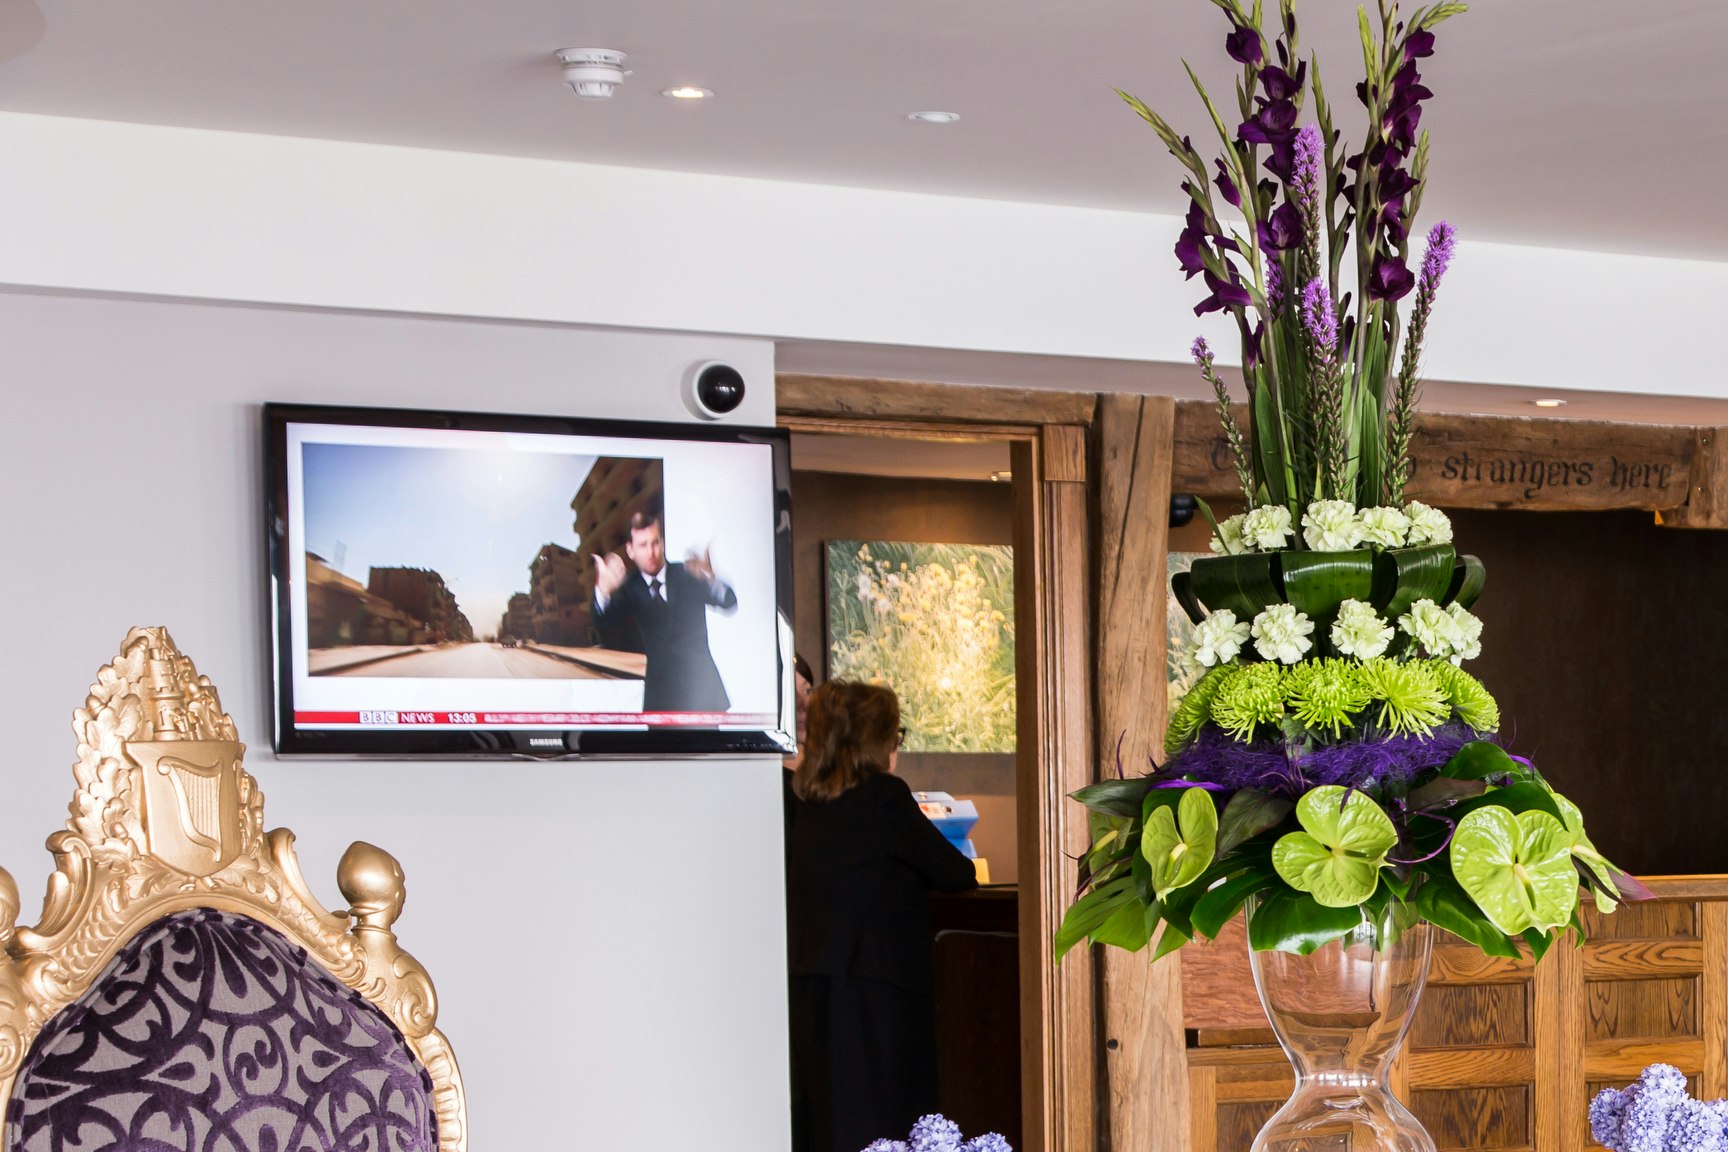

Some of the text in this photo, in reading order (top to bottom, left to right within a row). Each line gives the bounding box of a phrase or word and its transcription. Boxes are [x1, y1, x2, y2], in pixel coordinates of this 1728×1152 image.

[1441, 451, 1595, 499] strangers
[1609, 455, 1673, 494] here
[360, 711, 435, 725] BBC NEWS
[448, 712, 477, 724] 13:05
[529, 737, 564, 747] SAMSUNG
